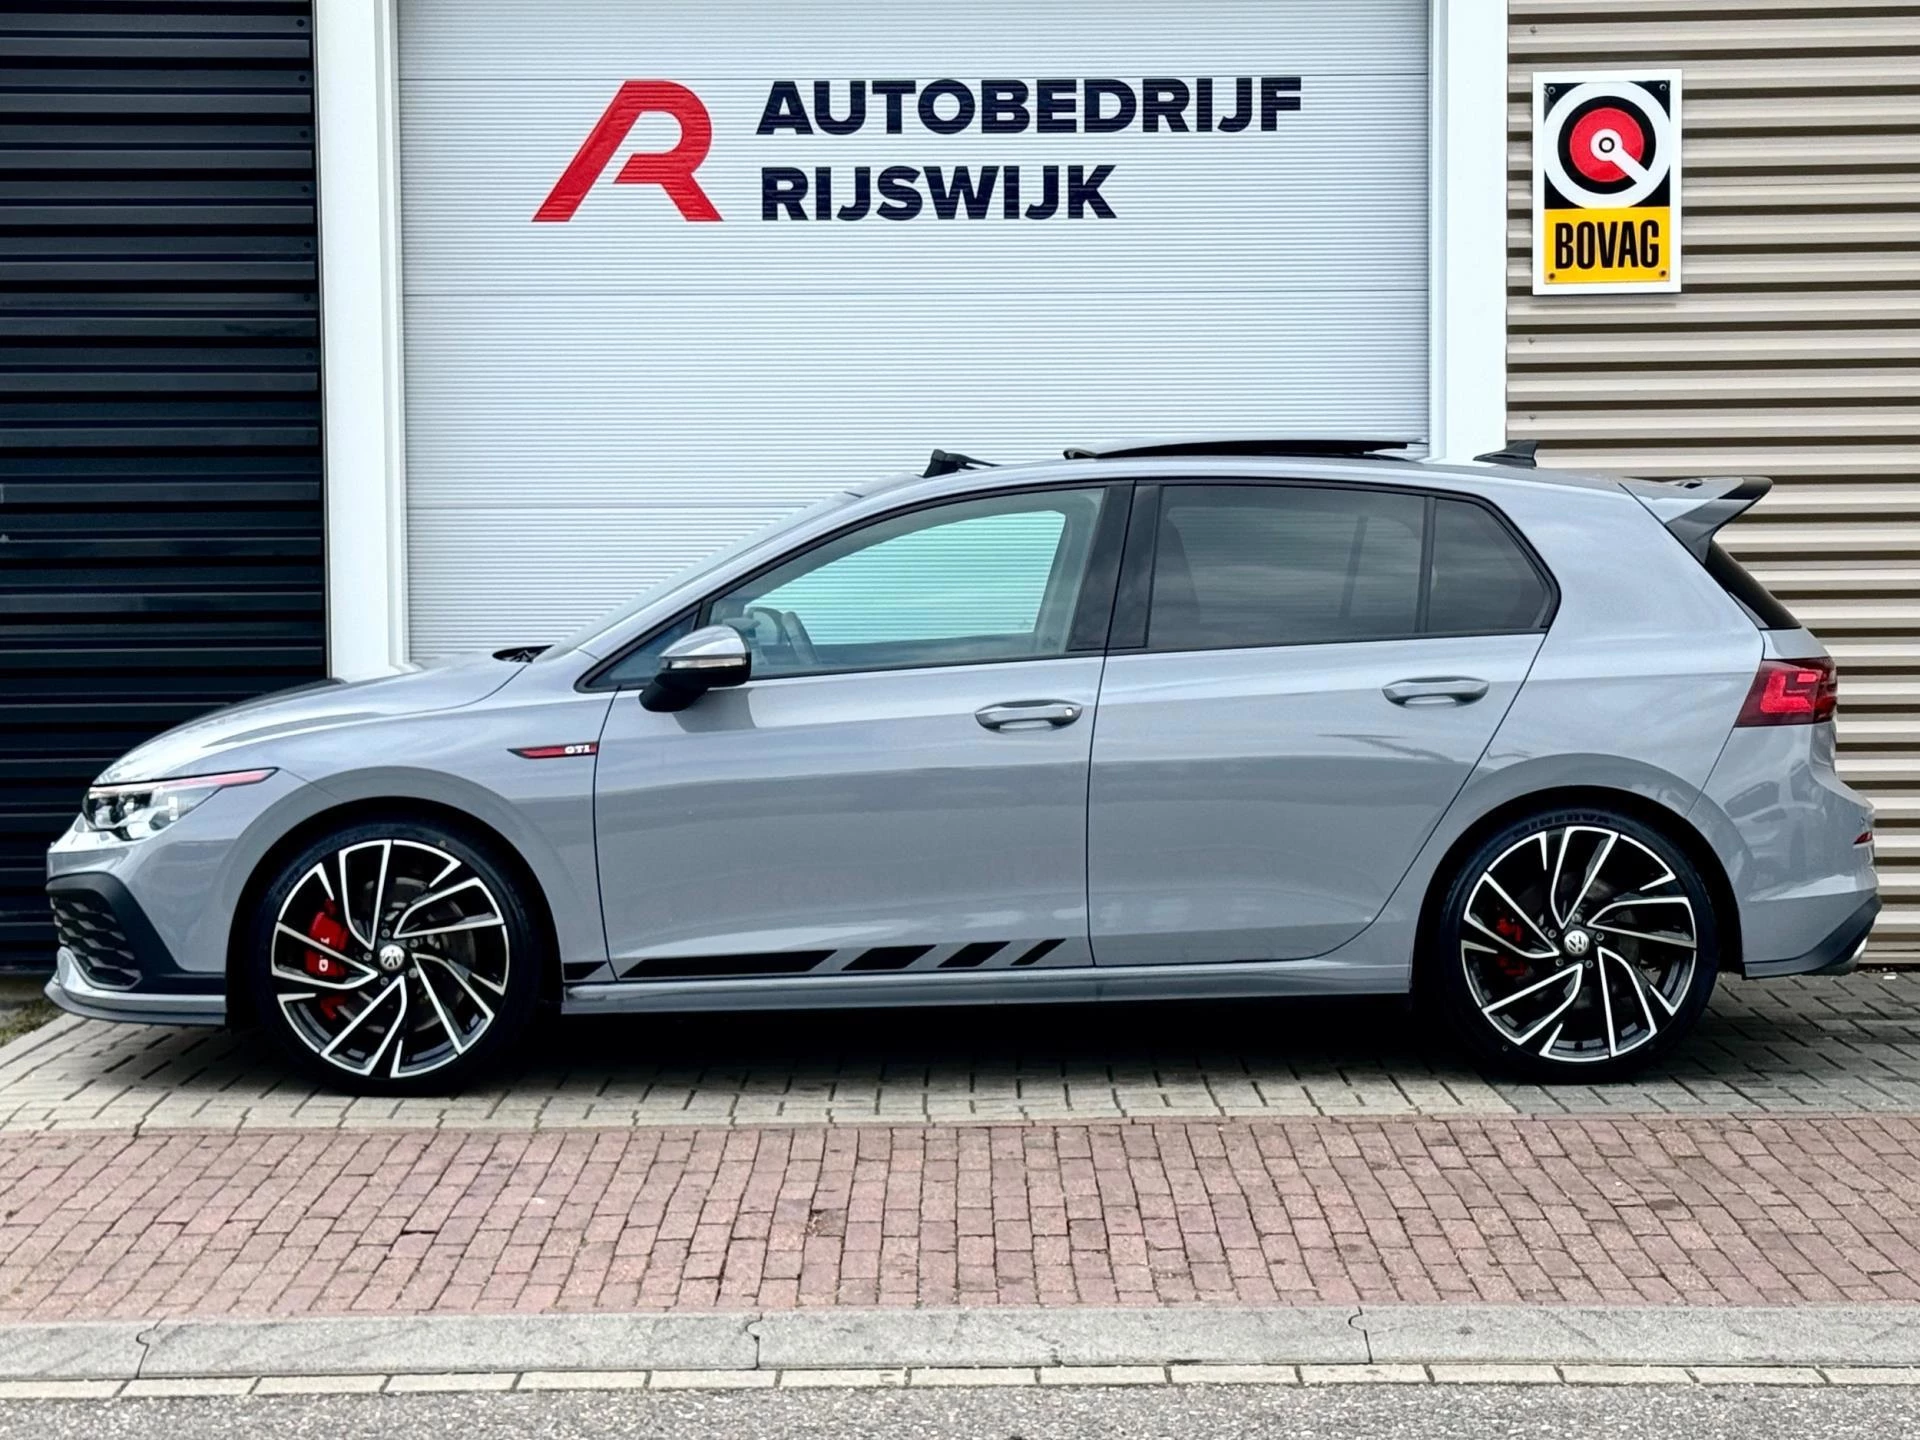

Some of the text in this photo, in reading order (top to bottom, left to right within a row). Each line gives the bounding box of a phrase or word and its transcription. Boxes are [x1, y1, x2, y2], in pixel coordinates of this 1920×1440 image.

[756, 76, 1302, 136] AUTOBEDRIJF
[761, 165, 1117, 222] RIJSWIJK
[1555, 219, 1659, 270] BOVAG
[564, 744, 591, 754] GTI
